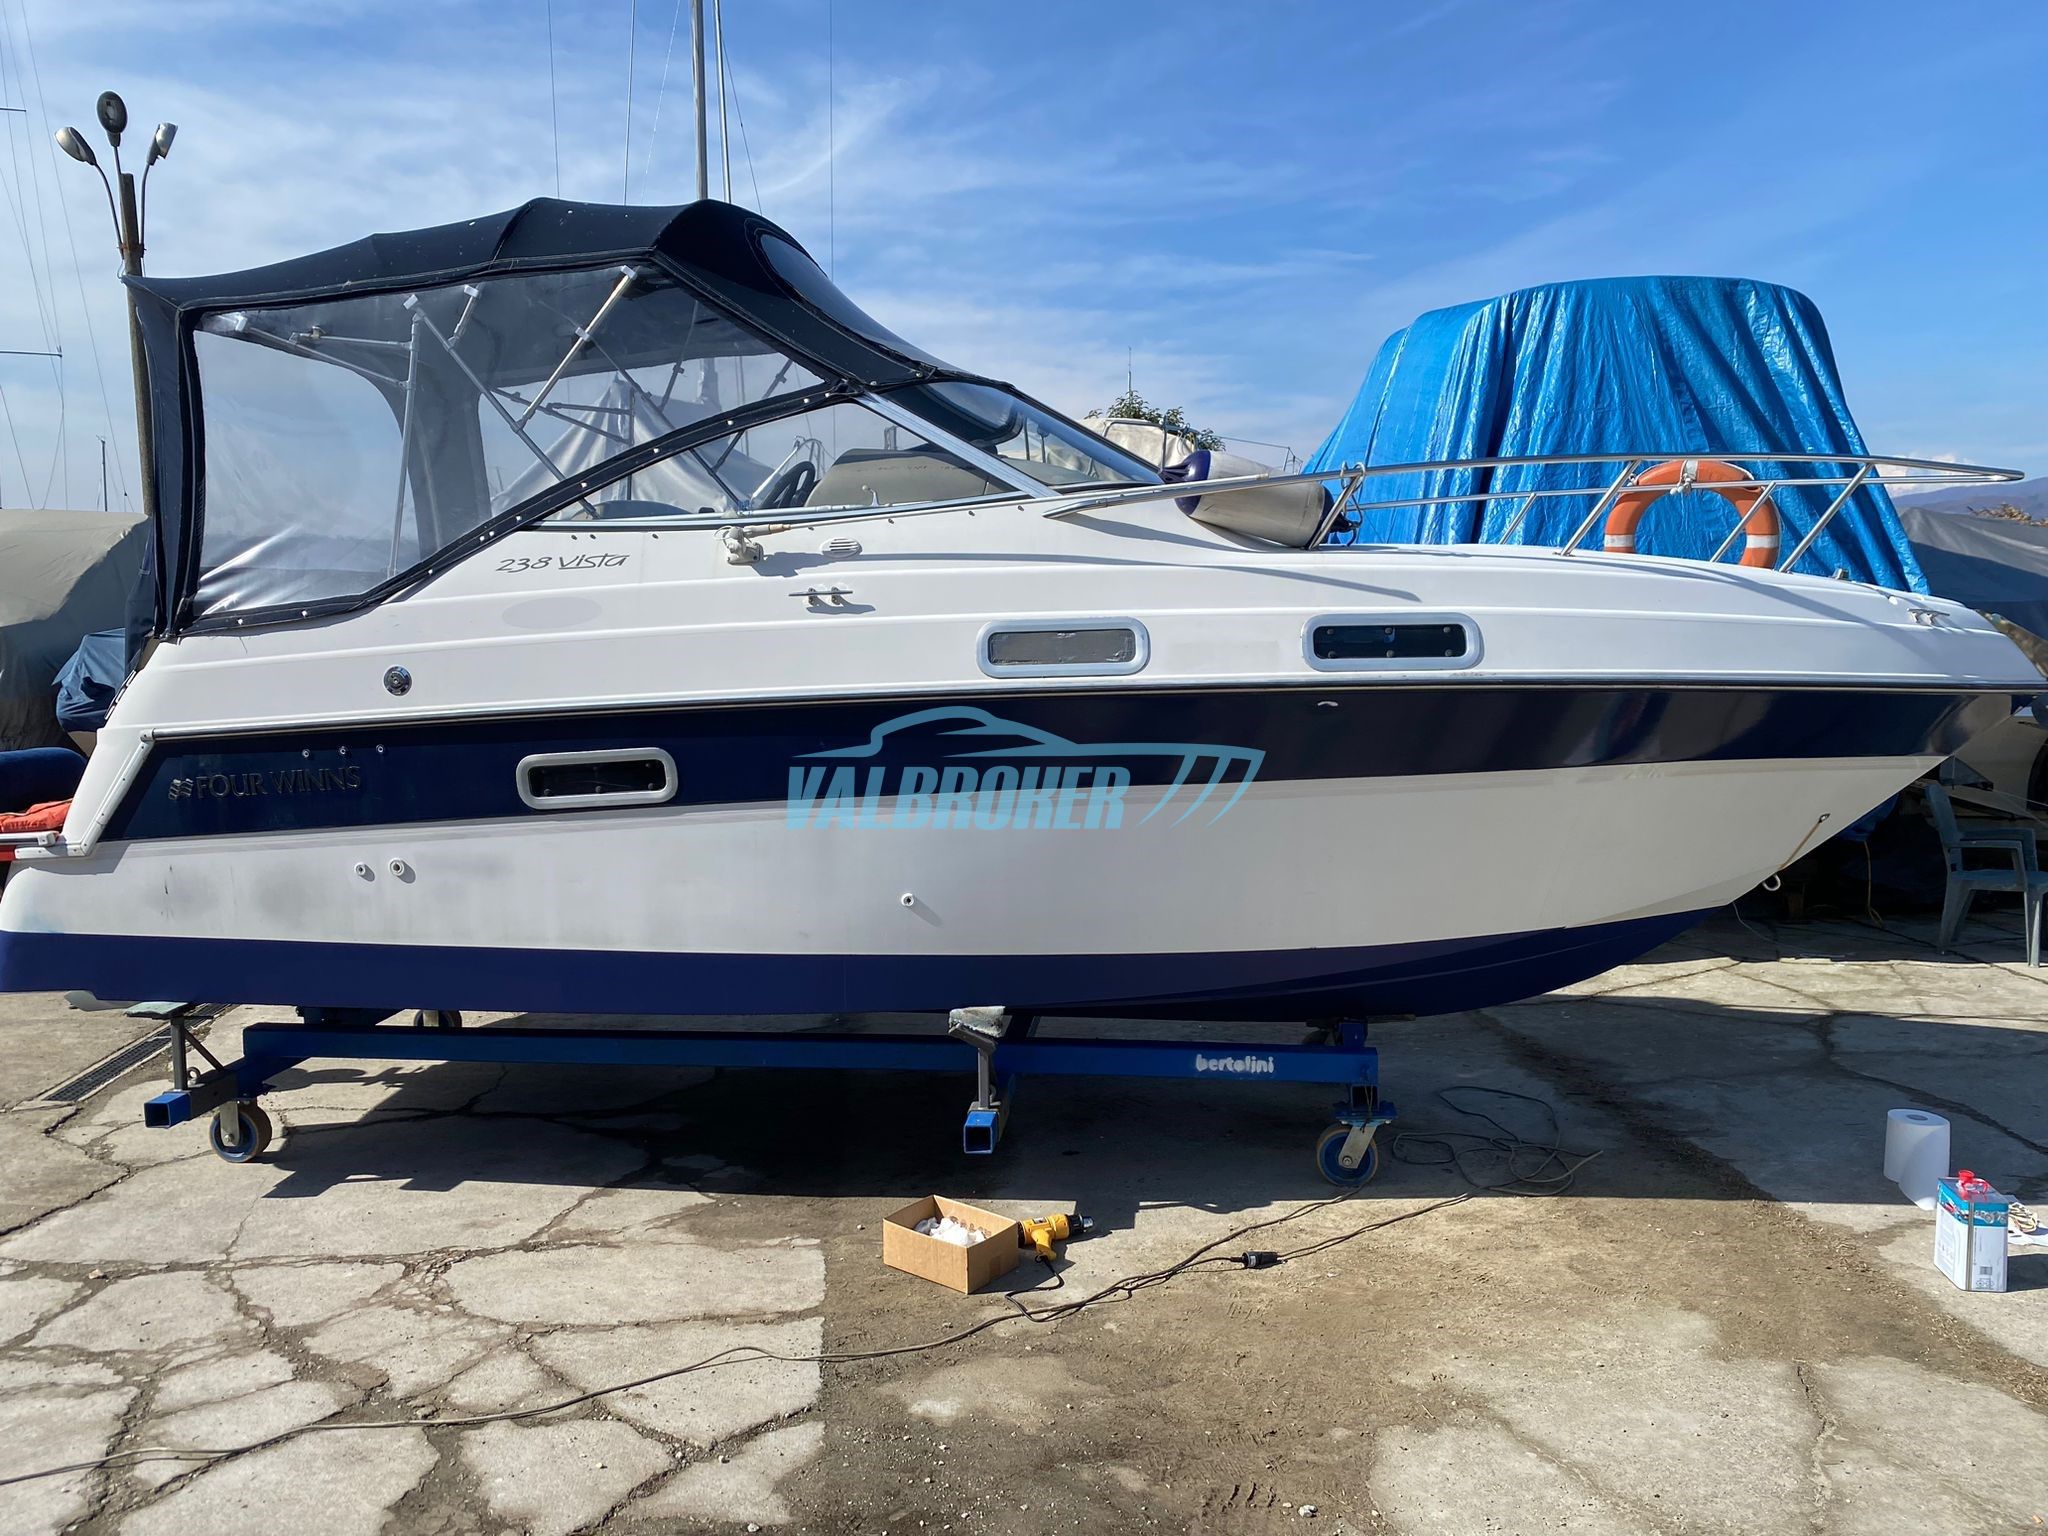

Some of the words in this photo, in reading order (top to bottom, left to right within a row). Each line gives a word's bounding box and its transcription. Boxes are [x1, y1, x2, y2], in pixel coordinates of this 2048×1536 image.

[495, 556, 553, 573] 238
[195, 773, 268, 799] FOUR
[269, 765, 361, 794] WINNS
[1195, 1053, 1275, 1074] bertolini
